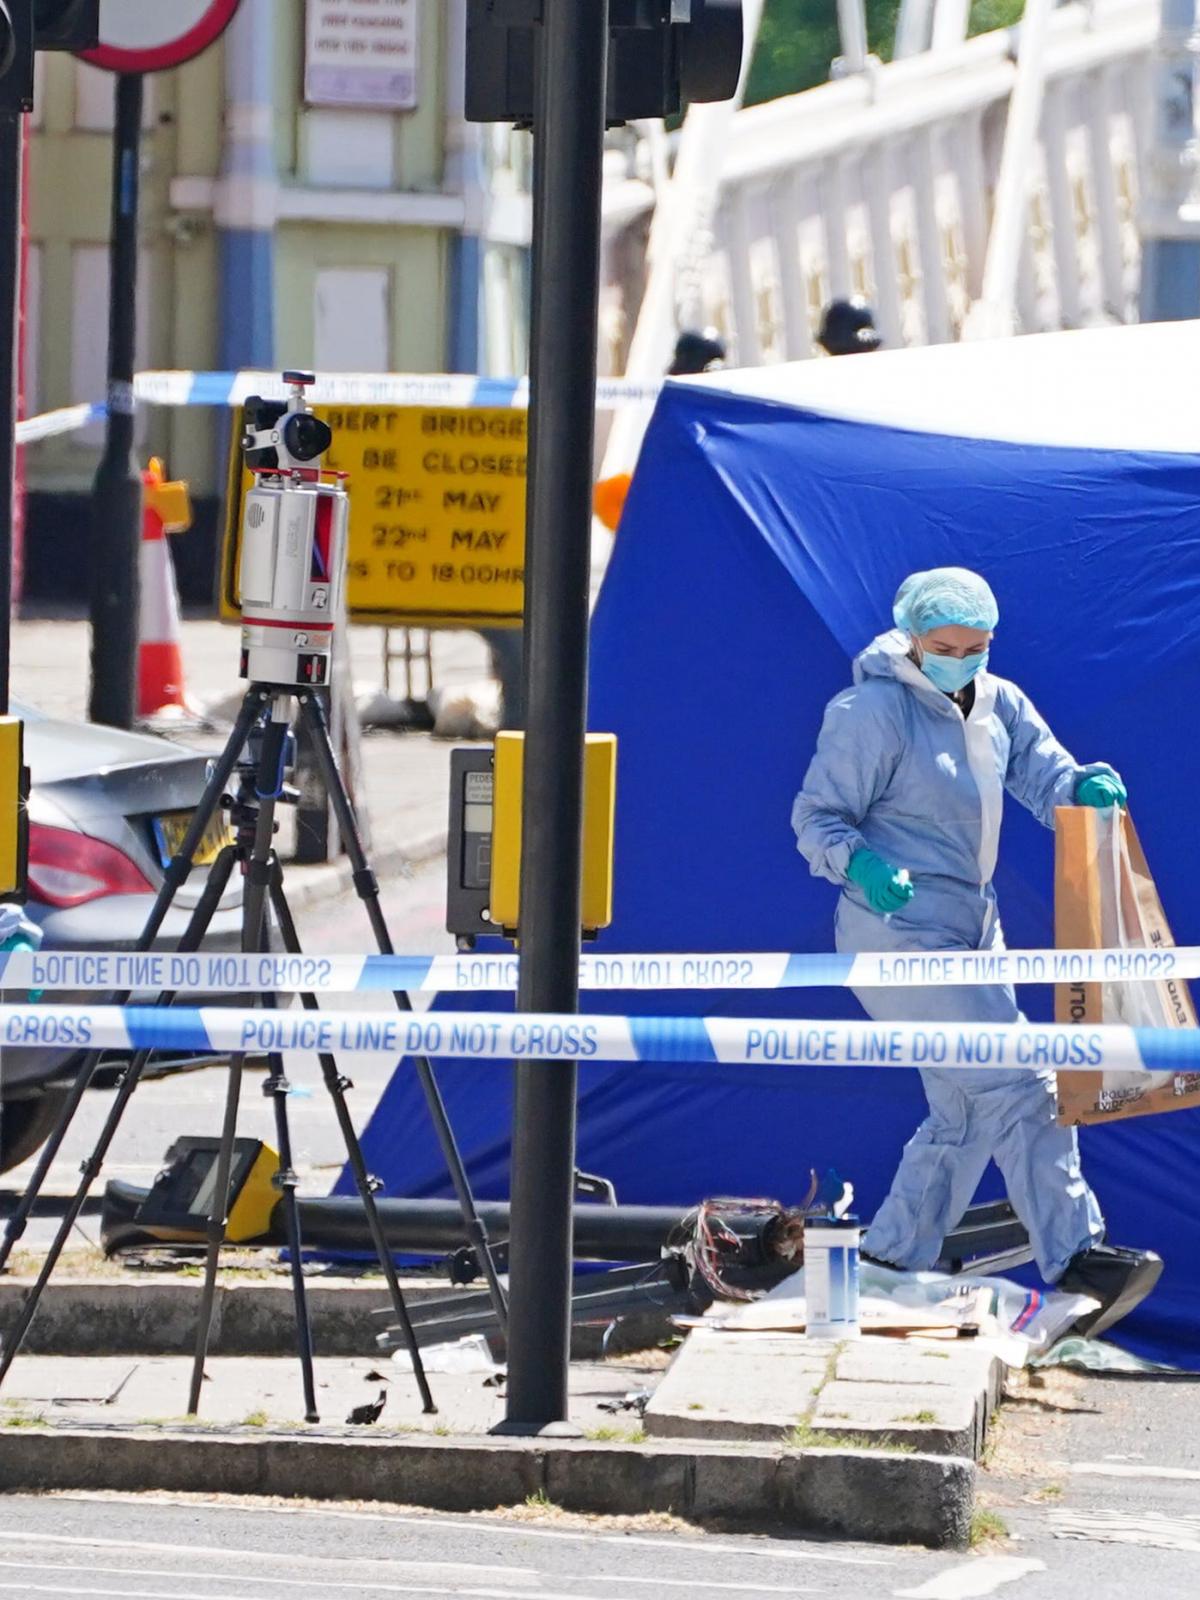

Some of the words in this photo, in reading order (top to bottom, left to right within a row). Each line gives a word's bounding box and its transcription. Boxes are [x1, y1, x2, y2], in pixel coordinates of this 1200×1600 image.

[327, 411, 398, 431] BERT
[362, 449, 397, 470] BE
[443, 490, 502, 512] MAY
[451, 530, 509, 551] MAY
[384, 560, 416, 581] TO
[1070, 982, 1086, 1024] OLI
[6, 1014, 92, 1044] CROSS
[240, 1018, 332, 1051] POLICE
[340, 1020, 397, 1051] LINE
[406, 1021, 443, 1053] DO
[450, 1023, 502, 1053] NOT
[510, 1024, 598, 1056] CROSS
[746, 1029, 837, 1060] POLICE
[846, 1030, 902, 1061] LINE
[911, 1031, 947, 1062] DO
[956, 1032, 1007, 1063] NOT
[1016, 1033, 1103, 1065] CROSS
